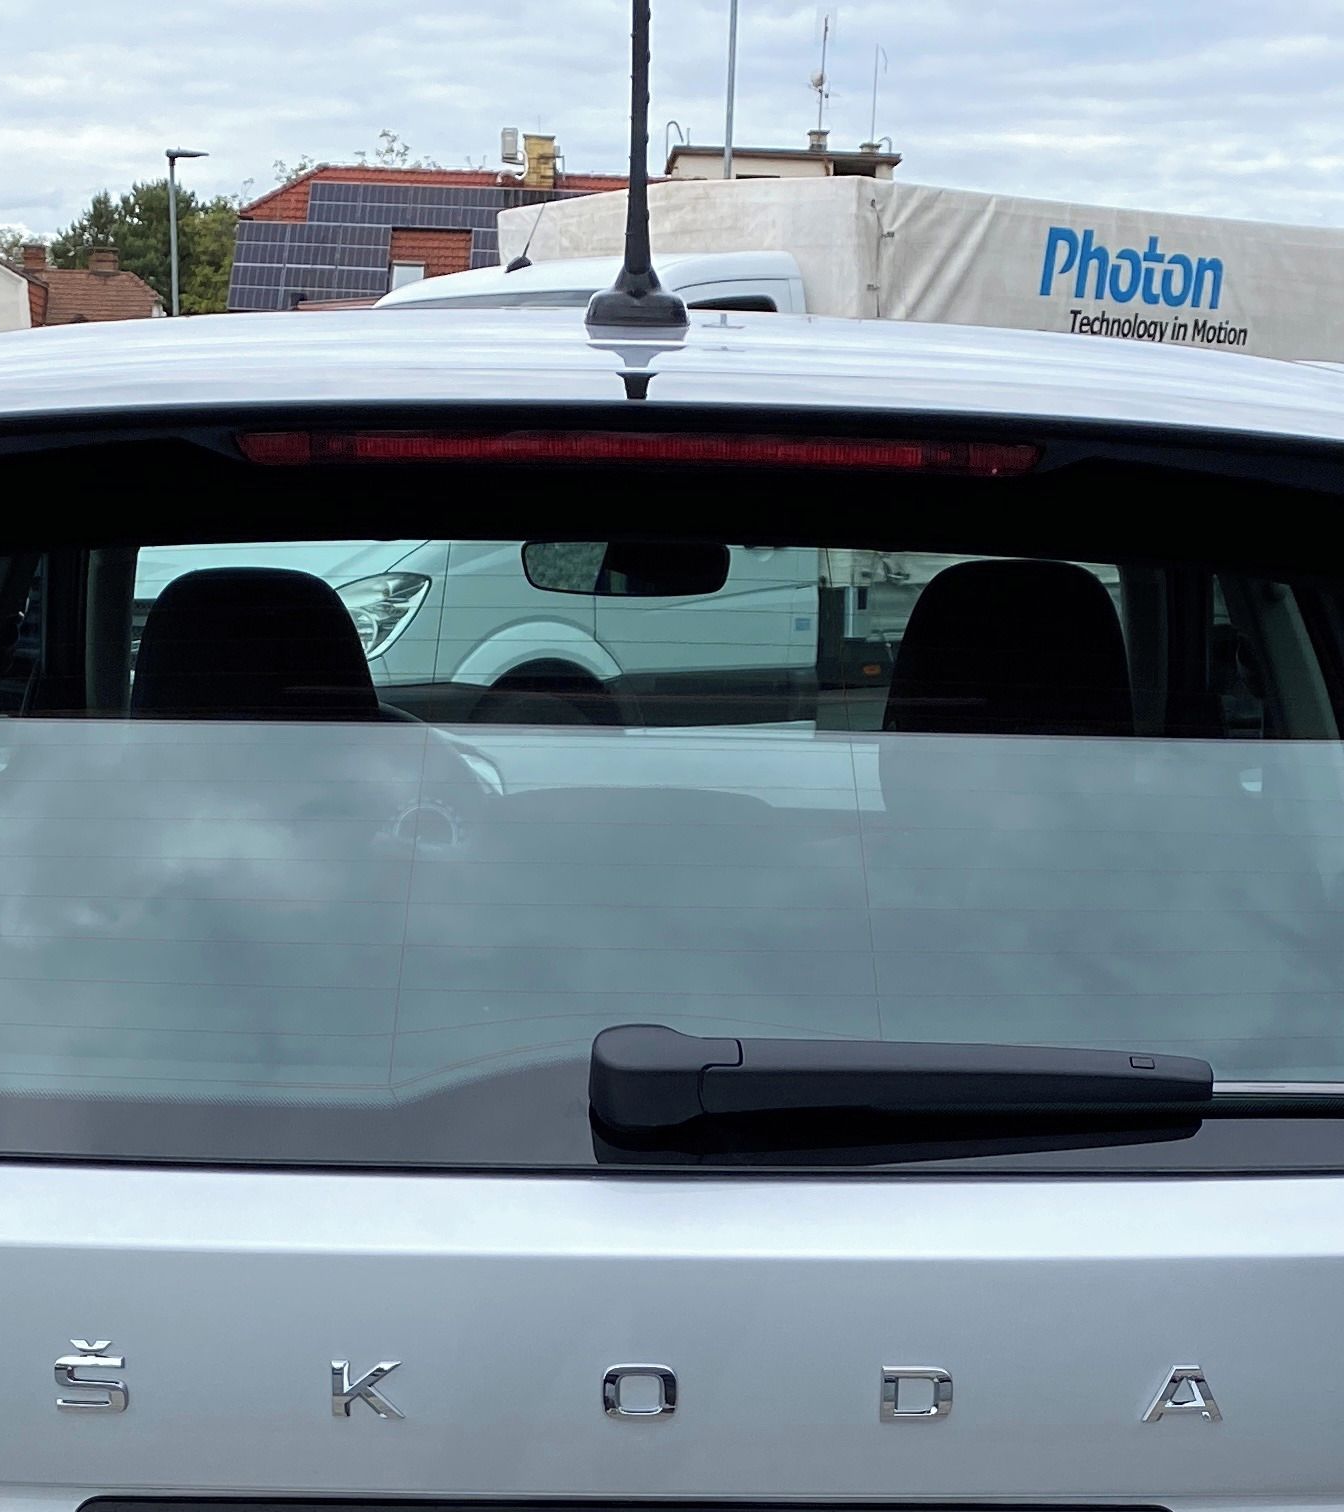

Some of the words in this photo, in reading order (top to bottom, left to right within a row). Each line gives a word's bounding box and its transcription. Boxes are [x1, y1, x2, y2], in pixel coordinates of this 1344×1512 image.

[1039, 226, 1224, 309] Photon
[1070, 309, 1168, 343] Technology
[1170, 316, 1188, 341] in
[1191, 318, 1249, 346] Motion
[54, 1338, 1223, 1423] ŠKODA
